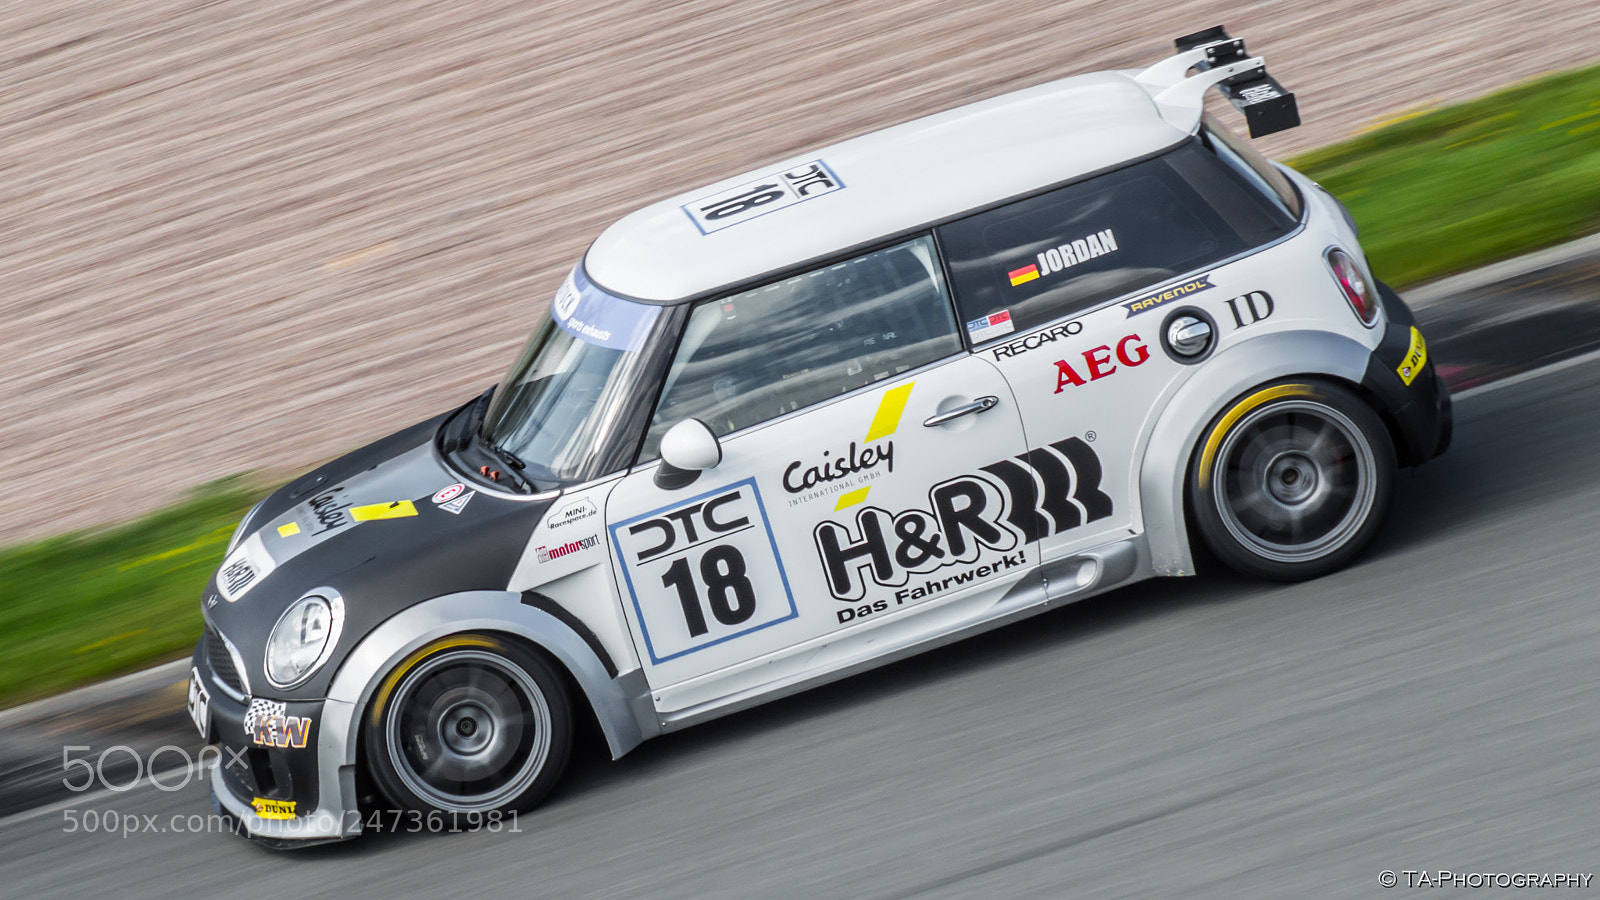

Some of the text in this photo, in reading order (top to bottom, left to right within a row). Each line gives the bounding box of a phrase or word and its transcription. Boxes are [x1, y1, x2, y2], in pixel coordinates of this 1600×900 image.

[700, 184, 786, 221] 18
[1036, 228, 1118, 277] JORDAN
[1130, 279, 1208, 313] RAVENOL
[1223, 289, 1275, 330] ID
[993, 321, 1083, 362] RECARO
[1053, 333, 1150, 395] AEG
[782, 440, 895, 494] Caisley
[788, 471, 881, 507] INTERNATIONAL GMBH
[550, 509, 597, 530] Racespace.de
[564, 505, 588, 518] MINI-
[549, 533, 600, 560] motorsport
[813, 475, 1018, 602] H&R
[661, 544, 757, 639] 18
[836, 550, 1027, 624] Das Fahrwerk!
[253, 714, 312, 748] KW
